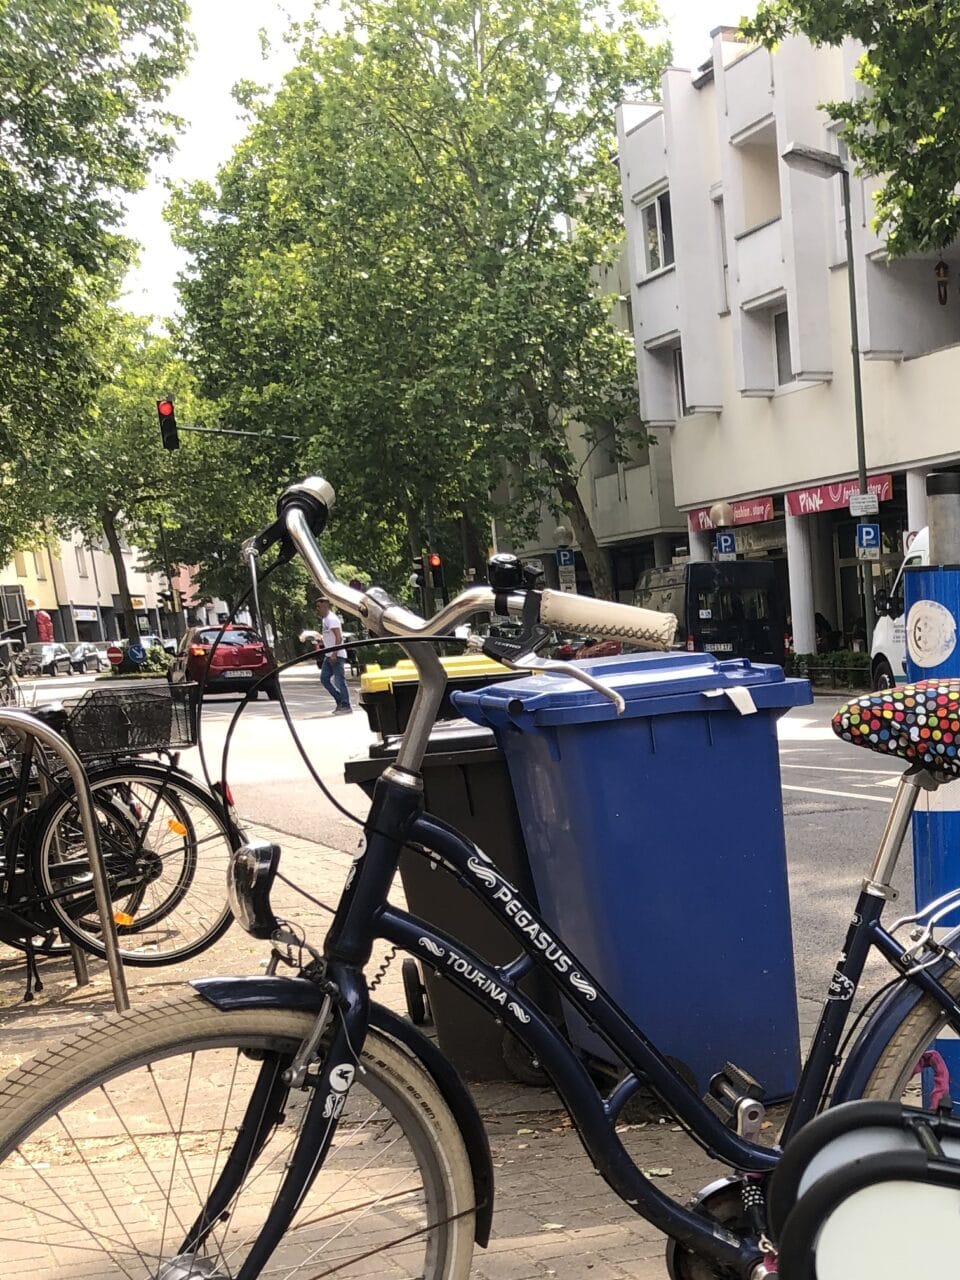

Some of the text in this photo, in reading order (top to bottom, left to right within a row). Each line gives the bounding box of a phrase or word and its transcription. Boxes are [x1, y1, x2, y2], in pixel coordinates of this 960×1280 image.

[721, 536, 732, 552] P
[862, 527, 875, 547] P
[560, 551, 570, 566] P
[493, 886, 572, 973] PEGASUS
[446, 951, 509, 1006] TOURINA
